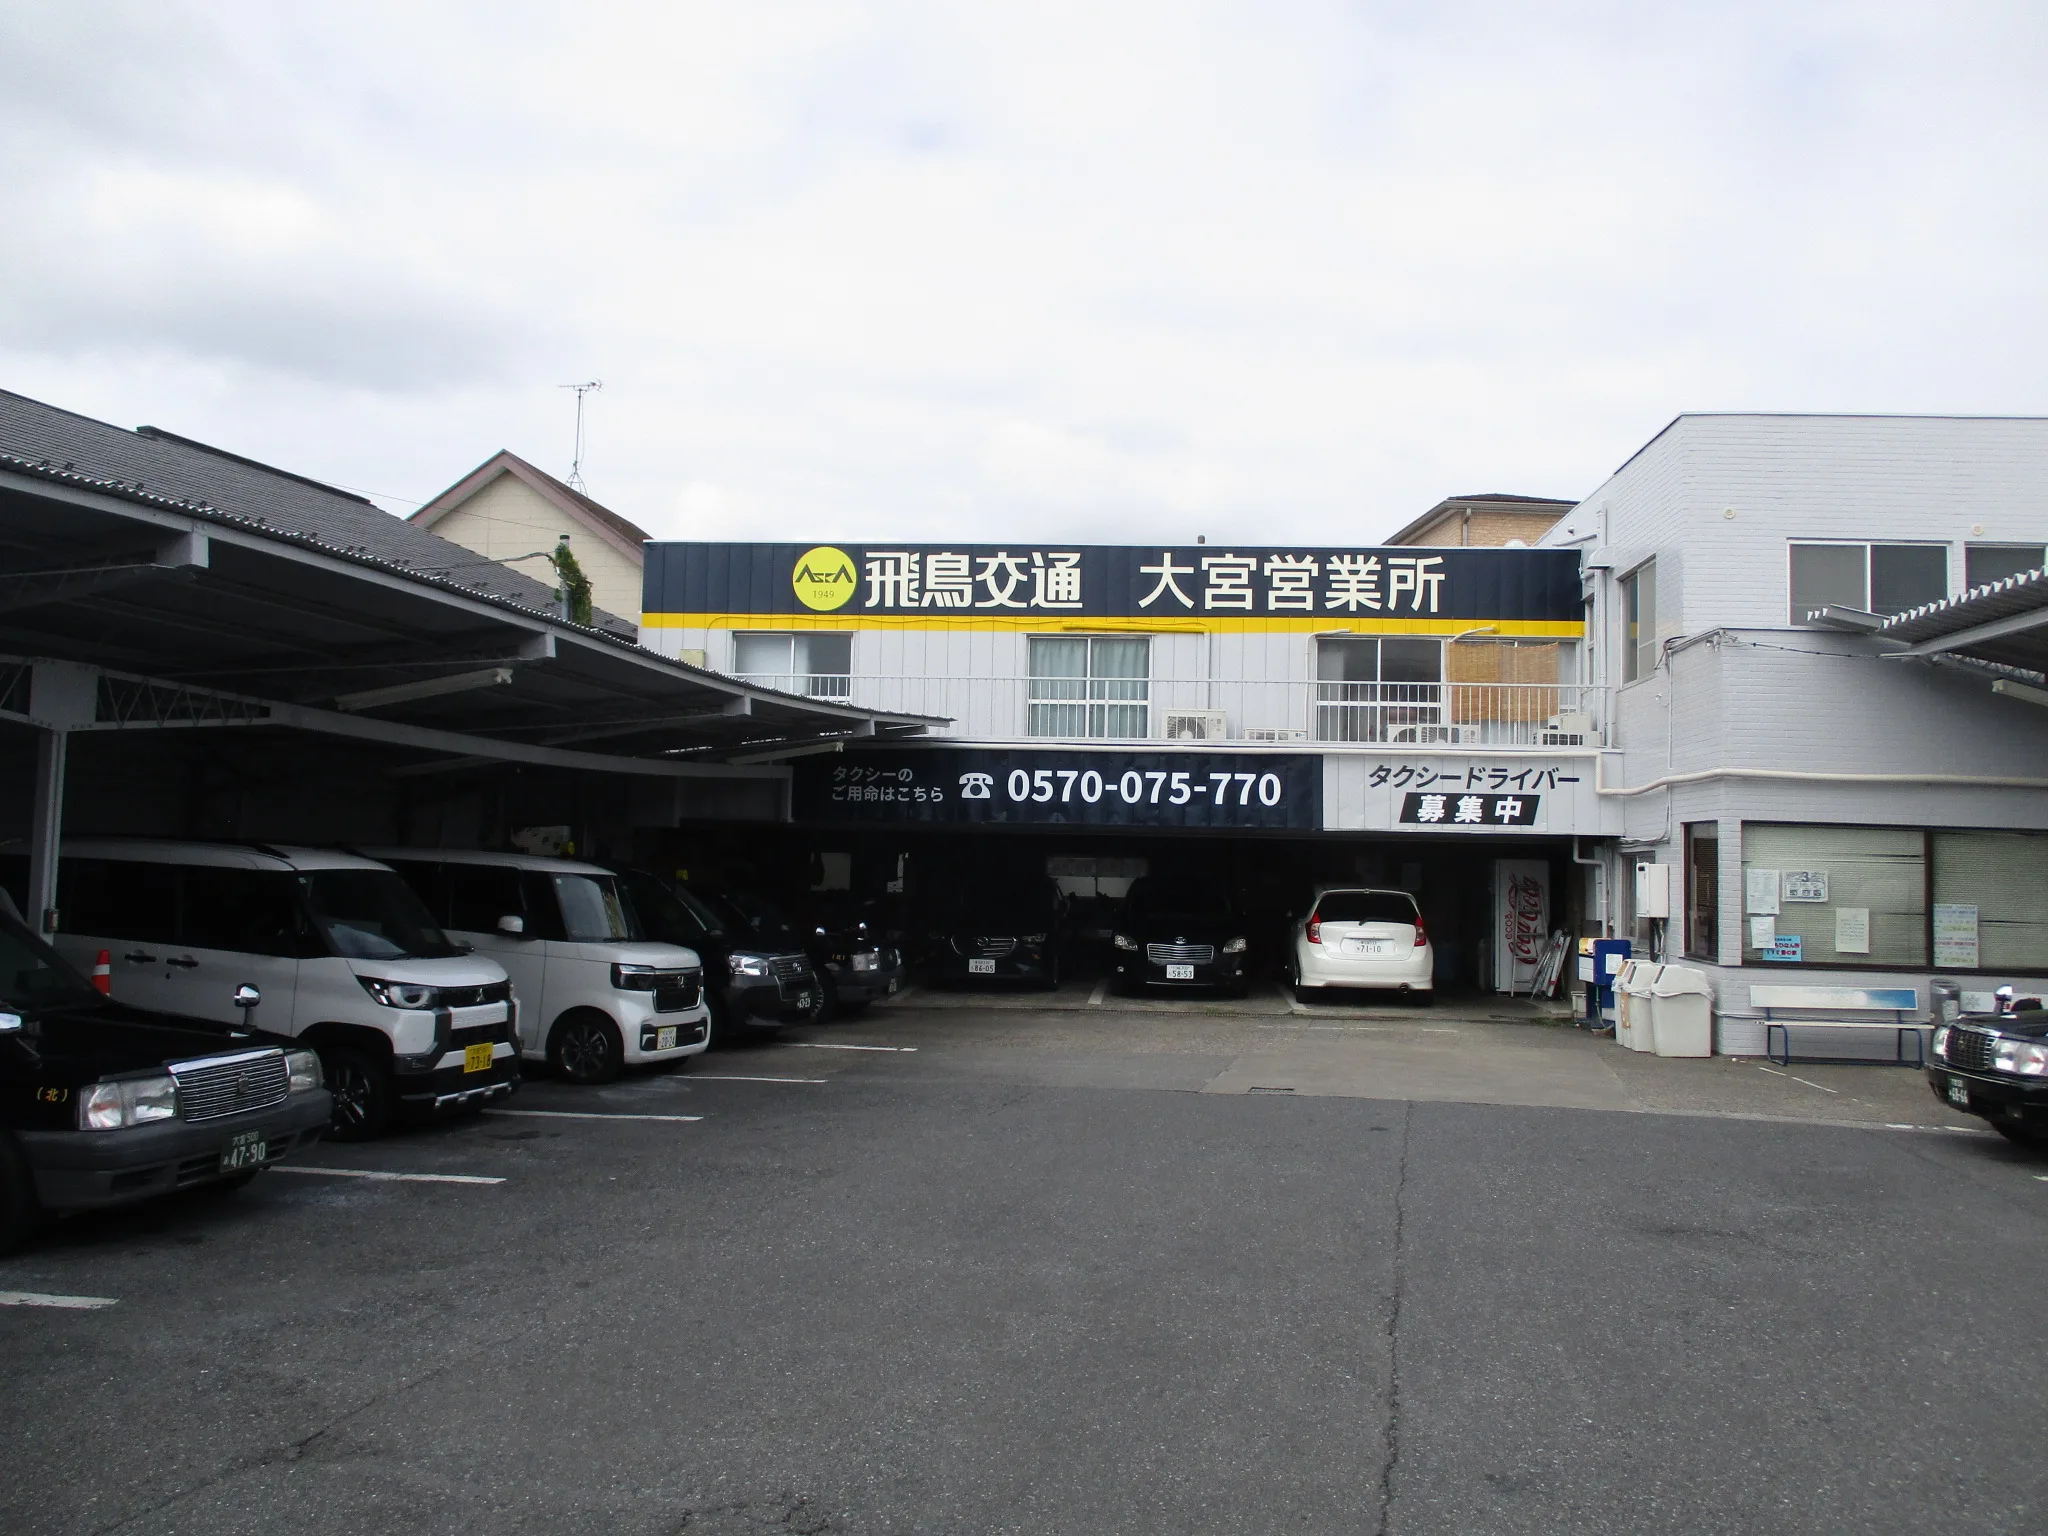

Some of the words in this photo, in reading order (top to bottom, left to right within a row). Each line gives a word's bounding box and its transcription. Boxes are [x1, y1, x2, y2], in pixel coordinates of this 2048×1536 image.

[865, 551, 1083, 608] 飛鳥交通
[1138, 552, 1446, 613] 大宮営業所
[813, 590, 835, 599] 1949
[832, 766, 913, 783] タクシーの
[1368, 763, 1581, 791] タクシードライバー
[831, 785, 945, 802] ご用命はこちら
[1007, 768, 1282, 808] 0570-075-770
[1416, 794, 1523, 825] 募集中
[1360, 945, 1382, 953] 71-10
[974, 964, 994, 973] 86-05
[1172, 970, 1193, 978] 58-53
[231, 1141, 266, 1168] 47-90
